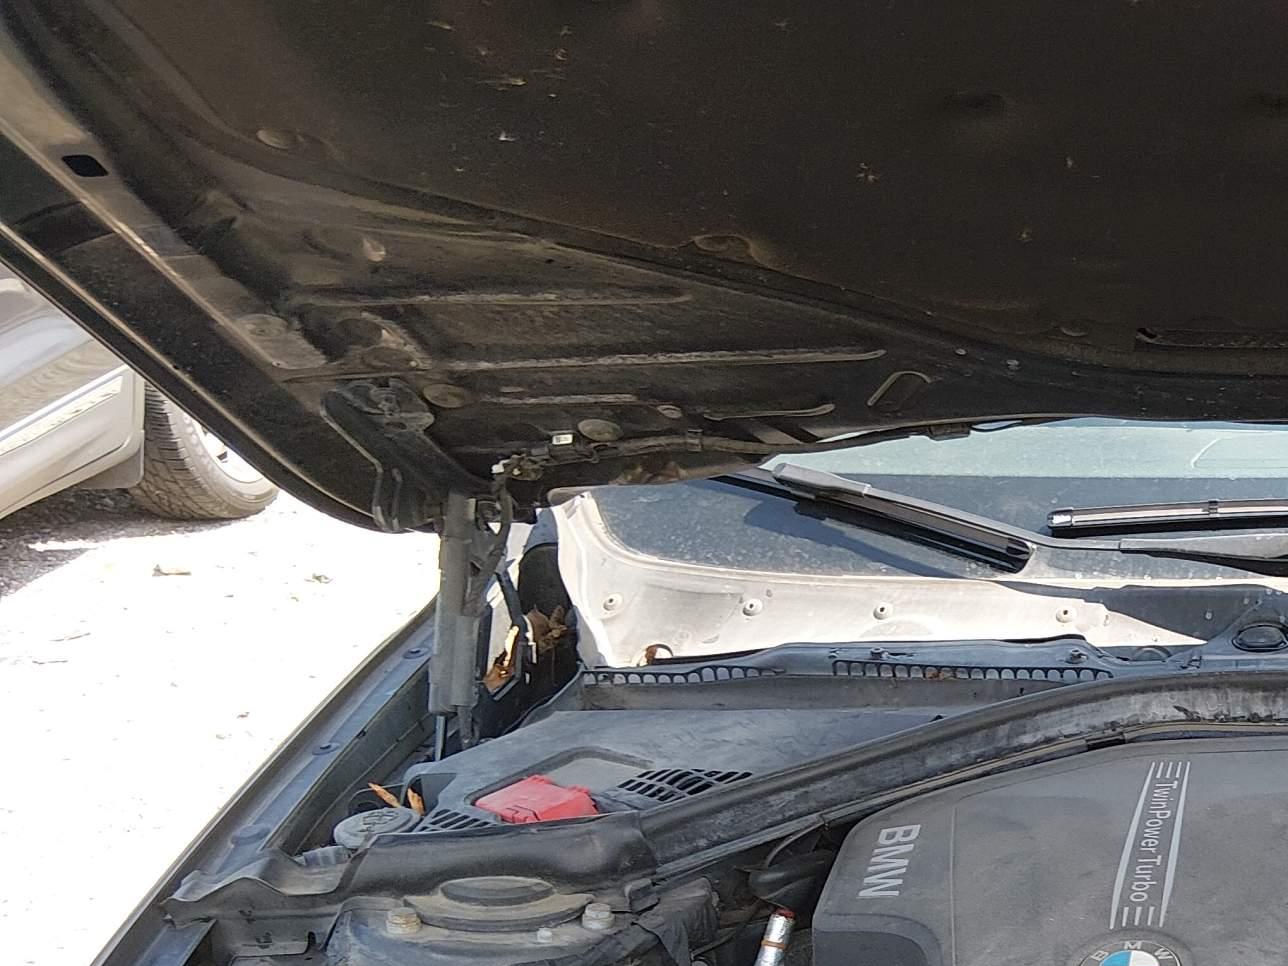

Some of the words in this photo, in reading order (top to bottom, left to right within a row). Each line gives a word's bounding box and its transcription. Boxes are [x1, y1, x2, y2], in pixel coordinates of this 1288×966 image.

[1140, 780, 1179, 854] TwinPower
[858, 824, 922, 897] BMW
[1129, 854, 1162, 902] Turbo
[1090, 940, 1175, 961] BMW
